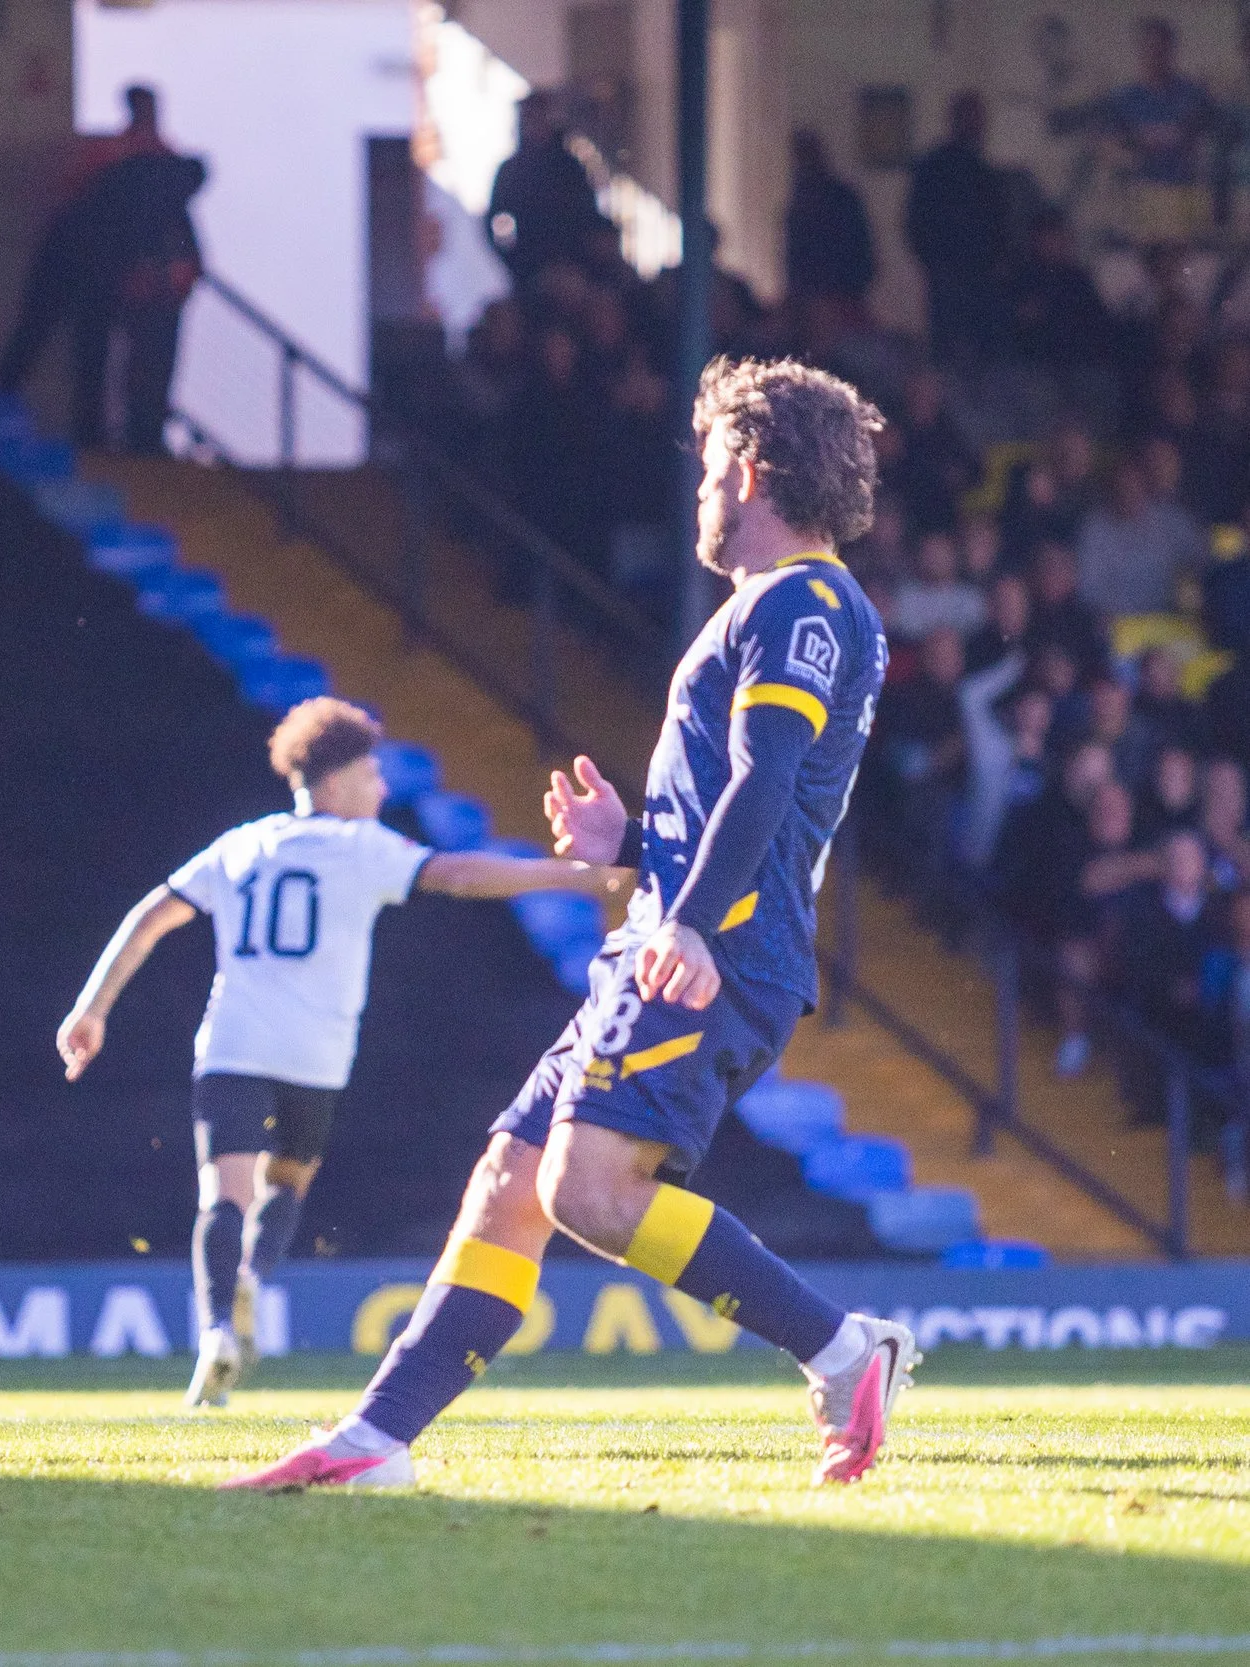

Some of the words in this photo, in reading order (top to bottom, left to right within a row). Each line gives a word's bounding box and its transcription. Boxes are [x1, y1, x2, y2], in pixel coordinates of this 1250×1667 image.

[234, 868, 319, 959] 10
[354, 1283, 743, 1354] GAY
[856, 1306, 1228, 1349] CTIONS
